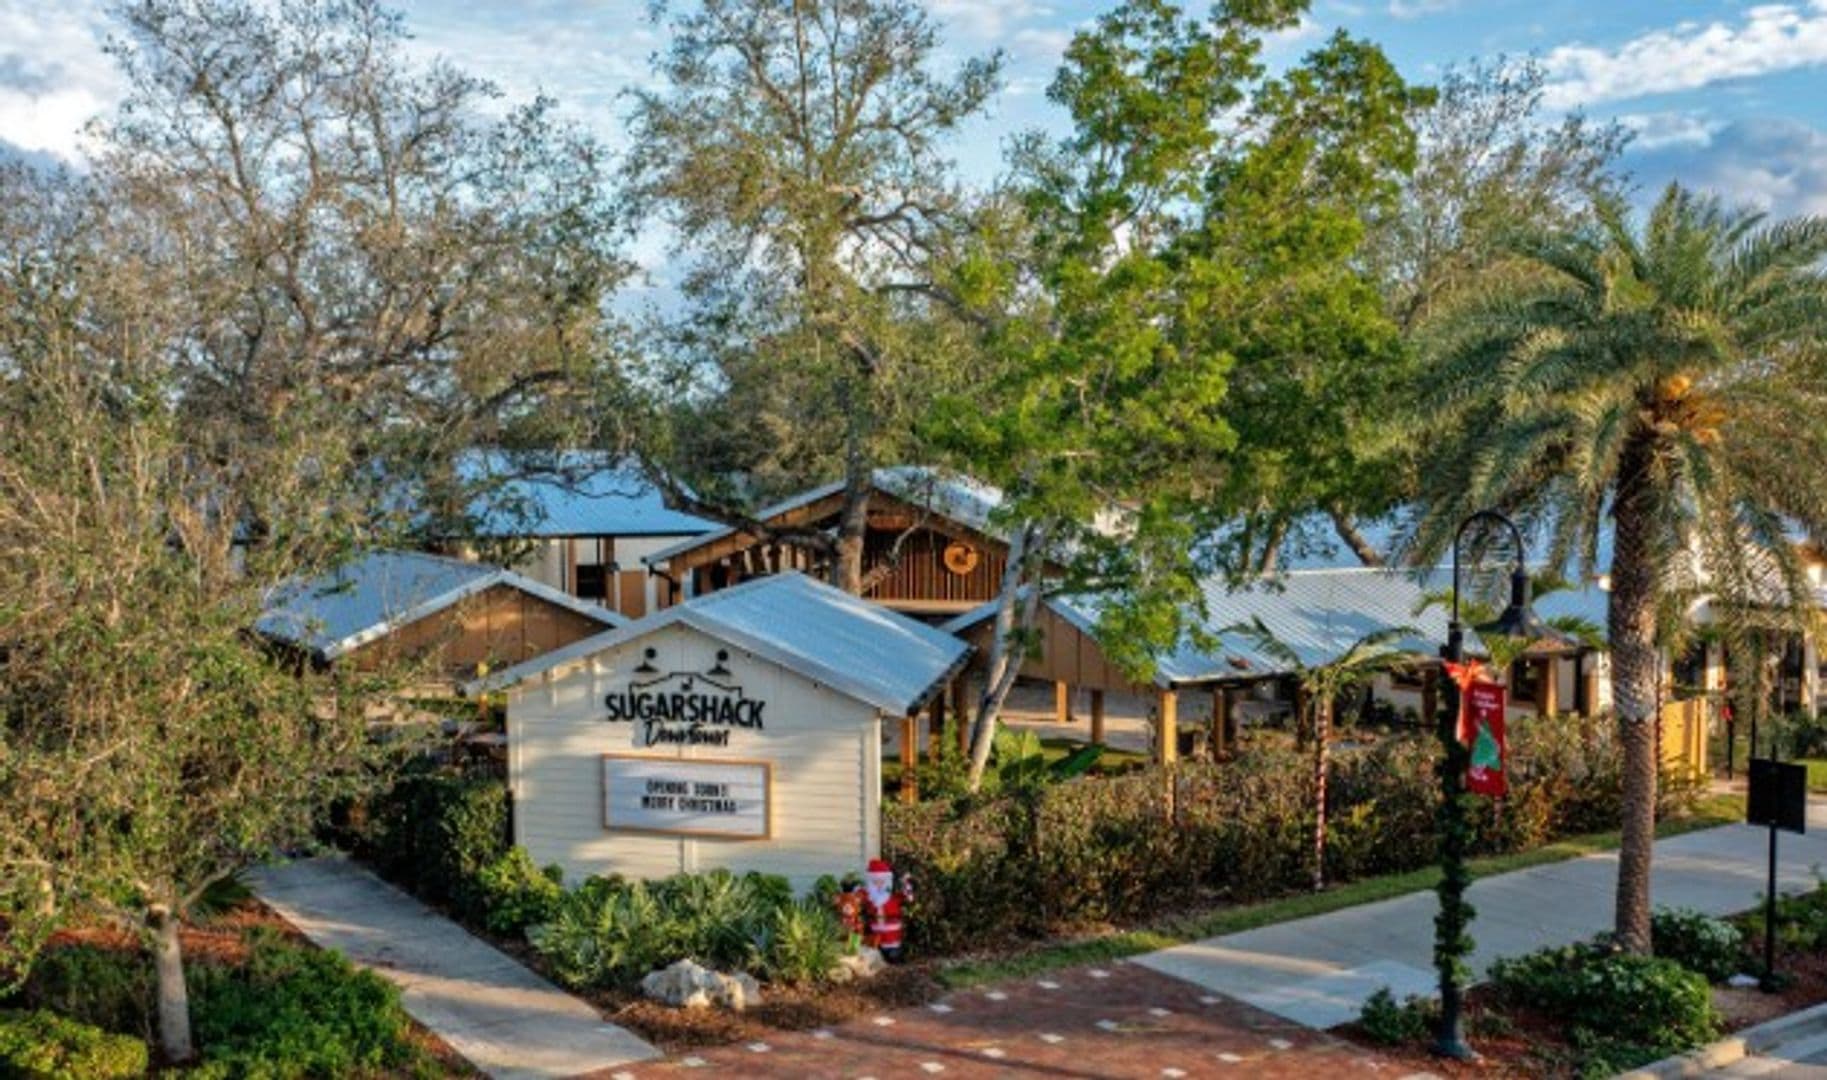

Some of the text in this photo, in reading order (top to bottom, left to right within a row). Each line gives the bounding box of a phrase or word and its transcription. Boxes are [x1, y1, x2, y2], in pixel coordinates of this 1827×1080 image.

[605, 693, 765, 729] SUGARSHACK
[646, 780, 688, 795] OPENING
[642, 796, 737, 813] MERRY CHRISTMAS
